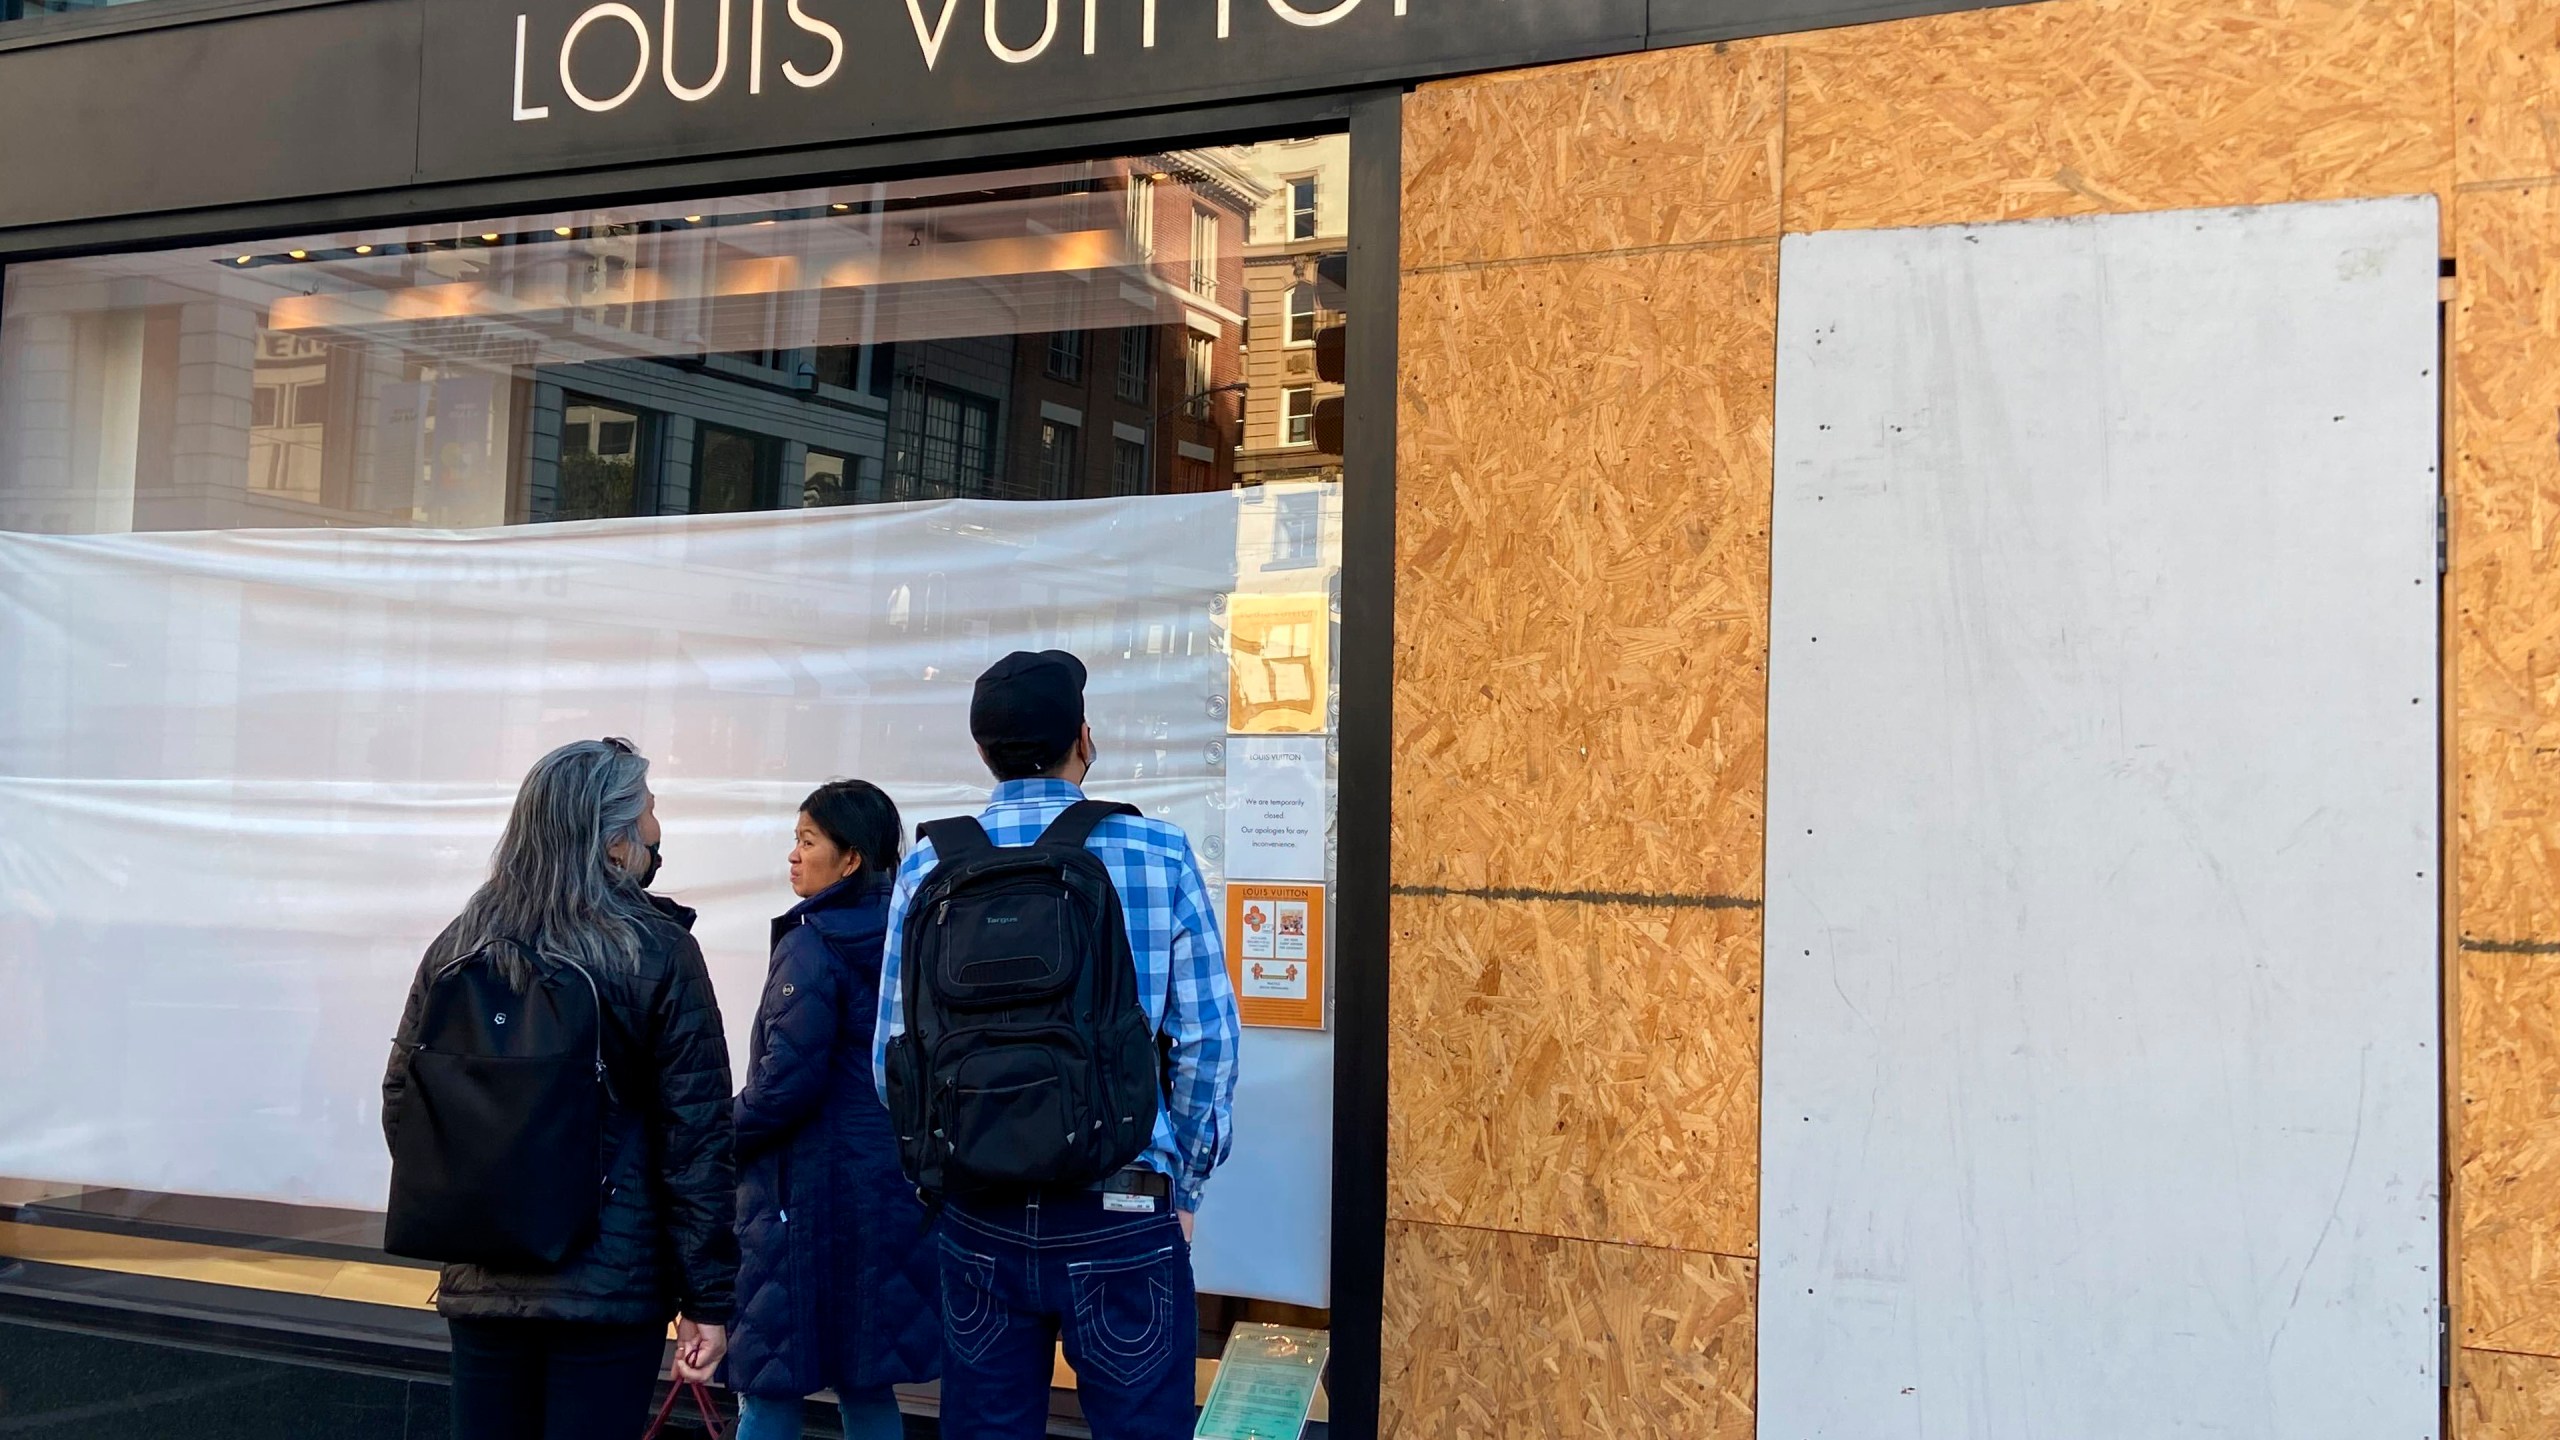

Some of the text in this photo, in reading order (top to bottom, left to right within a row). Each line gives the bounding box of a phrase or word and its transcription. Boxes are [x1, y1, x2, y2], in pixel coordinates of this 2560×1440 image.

[513, 0, 843, 121] LOUIS
[1249, 753, 1270, 761] LOUIS
[1270, 799, 1304, 807] temporarily
[1241, 826, 1308, 837] Our apologies for any
[1243, 888, 1308, 897] LOUIS VUITTON
